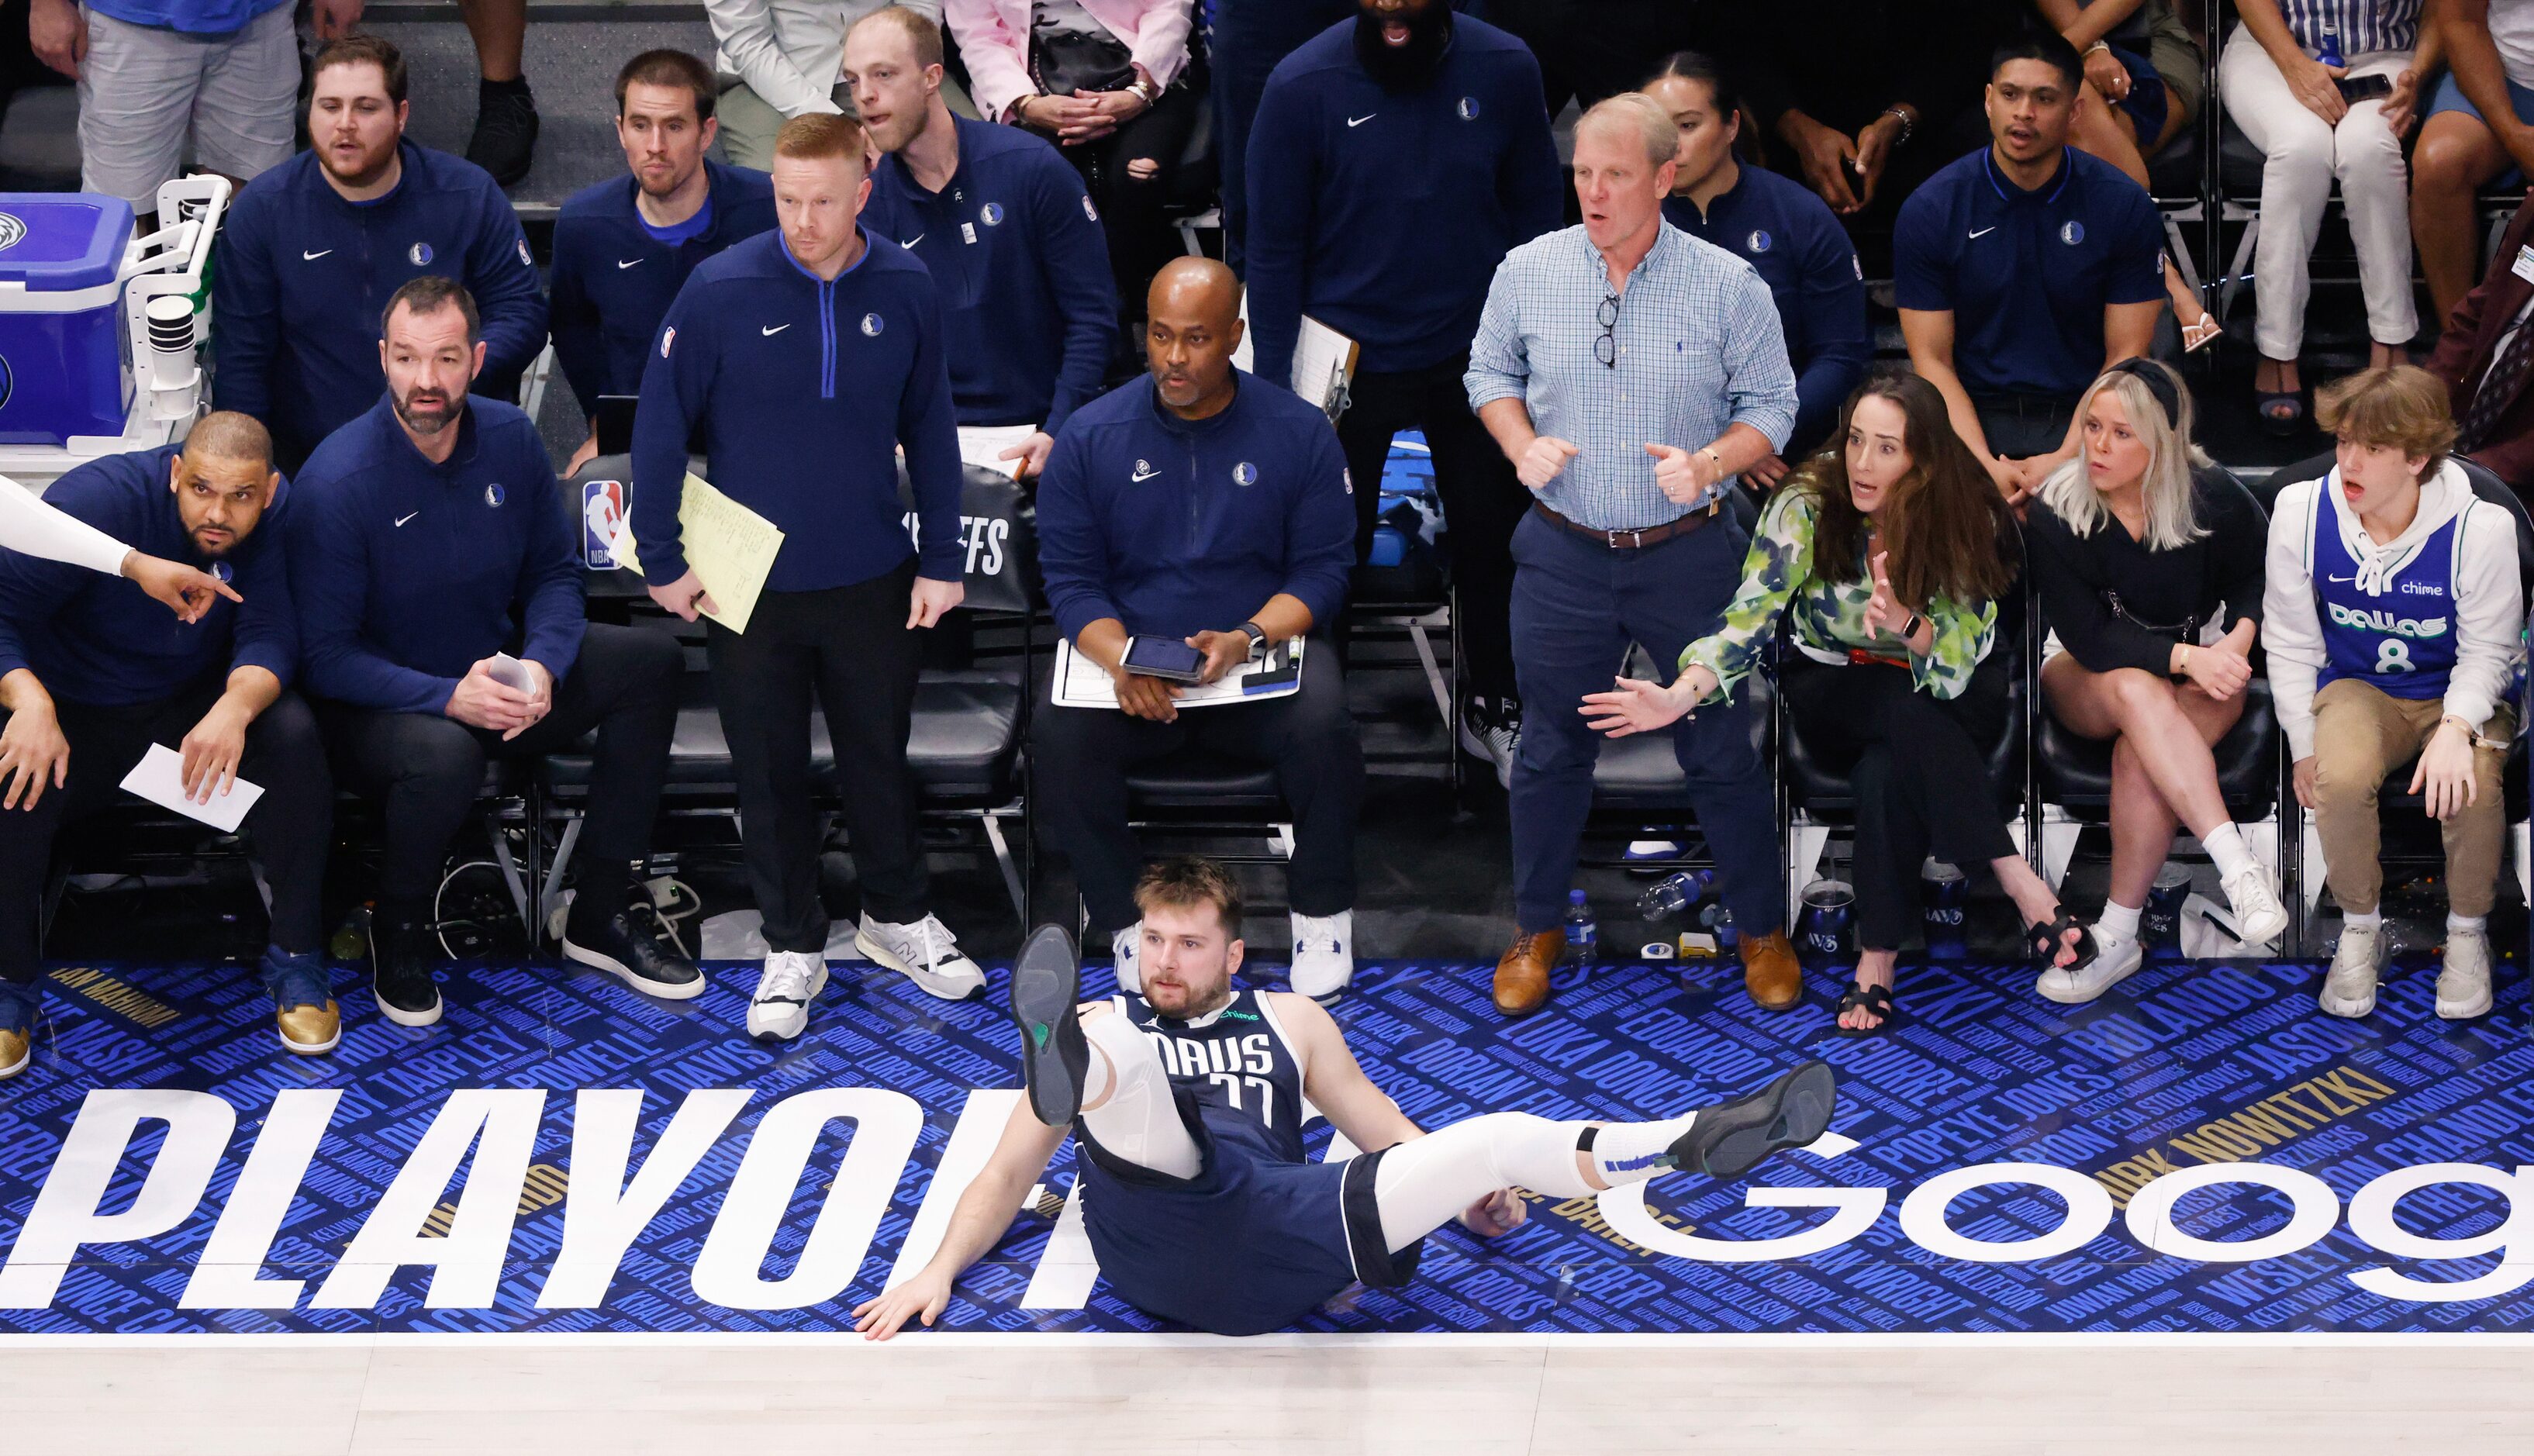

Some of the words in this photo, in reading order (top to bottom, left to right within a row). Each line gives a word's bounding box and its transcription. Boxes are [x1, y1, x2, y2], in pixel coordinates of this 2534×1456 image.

[590, 550, 610, 564] NBA
[2401, 581, 2443, 595] chime
[2375, 638, 2415, 674] 8
[48, 968, 99, 988] IAN
[80, 977, 181, 1028] MAHINMI
[561, 971, 607, 992] JIM
[589, 983, 683, 1033] SPANARKEL
[1417, 976, 1476, 1003] CALVIN
[1627, 972, 1674, 999] JONES
[471, 998, 540, 1030] AL-FAROUQ
[523, 1023, 577, 1048] AMINU
[517, 988, 602, 1027] TRENT
[1220, 1010, 1259, 1022] chime
[1350, 1011, 1424, 1045] MACK
[1379, 989, 1429, 1013] DANNY
[1414, 1006, 1474, 1035] FORTSON
[1697, 1011, 1733, 1027] RYAN
[2056, 962, 2284, 1067] ROLANDO
[2170, 1030, 2237, 1063] BRIAN
[2229, 992, 2318, 1037] HOWARD
[43, 1019, 166, 1077] NASH
[1361, 1041, 1393, 1056] JONES
[1491, 1010, 1616, 1068] LUKA
[1615, 1008, 1773, 1083] EDUARDO
[1714, 989, 1837, 1045] MARK
[1804, 1037, 1974, 1107] AGUIRRE
[1949, 1023, 2014, 1052] TERRY
[1994, 1044, 2056, 1074] TYLER
[1985, 1014, 2014, 1027] JIM
[2002, 1023, 2052, 1046] FARMER
[2232, 1016, 2381, 1081] JASON
[2401, 1028, 2437, 1044] FRED
[128, 1061, 186, 1087] THOMAS
[366, 1025, 529, 1098] TARPLEY
[505, 1032, 664, 1090] POWELL
[647, 1036, 778, 1098] DAVIS
[806, 1049, 852, 1071] PROUD
[816, 1025, 883, 1057] ROWDY
[854, 1050, 936, 1089] LOREN
[883, 1025, 945, 1053] YOGI
[918, 1037, 1017, 1089] FERRELL
[1394, 1037, 1539, 1106] DORIAN
[1895, 1024, 1968, 1067] DOMINIQUE
[1959, 1051, 2013, 1081] JONES
[2106, 1061, 2147, 1082] RICKY
[2137, 1050, 2176, 1068] LEDO
[2348, 1047, 2388, 1065] LOY
[2371, 1059, 2432, 1087] VAUGHT
[2383, 1041, 2420, 1057] JOHN
[2407, 1052, 2456, 1075] JENKINS
[12, 1092, 61, 1116] ERIC
[55, 1073, 105, 1100] RILEY
[1210, 1073, 1273, 1129] 77
[1581, 1092, 1609, 1106] KRIS
[1835, 1080, 1875, 1099] JOHNNY
[1861, 1093, 1924, 1123] NEWMAN
[2070, 1092, 2126, 1120] DEXTER
[2114, 1063, 2197, 1100] CAMBRIDGE
[2090, 1105, 2154, 1137] PEJA
[2126, 1056, 2258, 1117] STOJAKOVIĆ
[2365, 1078, 2484, 1130] RAYMOND
[1869, 1104, 2020, 1173] POPEYE
[1994, 1064, 2115, 1122] JONES
[2123, 1127, 2159, 1145] NICK
[2148, 1106, 2210, 1134] FAZEKAS
[2167, 1065, 2397, 1163] NOWITZKI
[2002, 1126, 2039, 1147] HARVEY
[1676, 1193, 1735, 1219] DAVID
[2208, 1203, 2250, 1230] BEST
[309, 1216, 363, 1242] KELVIN
[54, 1266, 154, 1325] VINCE
[650, 1264, 704, 1305] ELLIS
[1444, 1268, 1559, 1321] ROOKS
[1533, 1240, 1666, 1309] KLEBER
[1650, 1253, 1731, 1290] DARREN
[1708, 1282, 1801, 1326] COLLISON
[1756, 1270, 1844, 1311] CURRY
[1863, 1260, 1979, 1323] WRIGHT
[1939, 1262, 2049, 1313] CALDERÓN
[2196, 1243, 2339, 1307] WESLEY
[610, 1289, 689, 1333] KHALID
[696, 1301, 728, 1322] ERIC
[1088, 1296, 1130, 1314] MIKE
[1113, 1308, 1163, 1331] JAMES
[1346, 1289, 1419, 1323] BURKE
[1399, 1285, 1494, 1330] HENDERSON
[1550, 1308, 1576, 1319] DAN
[1568, 1297, 1611, 1317] DARRELL
[1599, 1313, 1641, 1332] ALLUMS
[1647, 1298, 1689, 1317] WALTER
[1677, 1313, 1720, 1333] PALMER
[1668, 1287, 1723, 1313] ANTHONY
[1709, 1307, 1762, 1332] JOHNSON
[1856, 1307, 1906, 1330] MEKEL
[2041, 1278, 2141, 1325] JUWAN
[2115, 1302, 2153, 1320] RAJON
[2143, 1287, 2185, 1307] RONDO
[2175, 1299, 2213, 1317] JOSH
[2199, 1311, 2242, 1331] GREEN
[2244, 1299, 2297, 1328] KEITH
[2292, 1277, 2337, 1313] VAN
[2355, 1305, 2390, 1329] MATT
[1834, 1316, 1870, 1334] RESPERT
